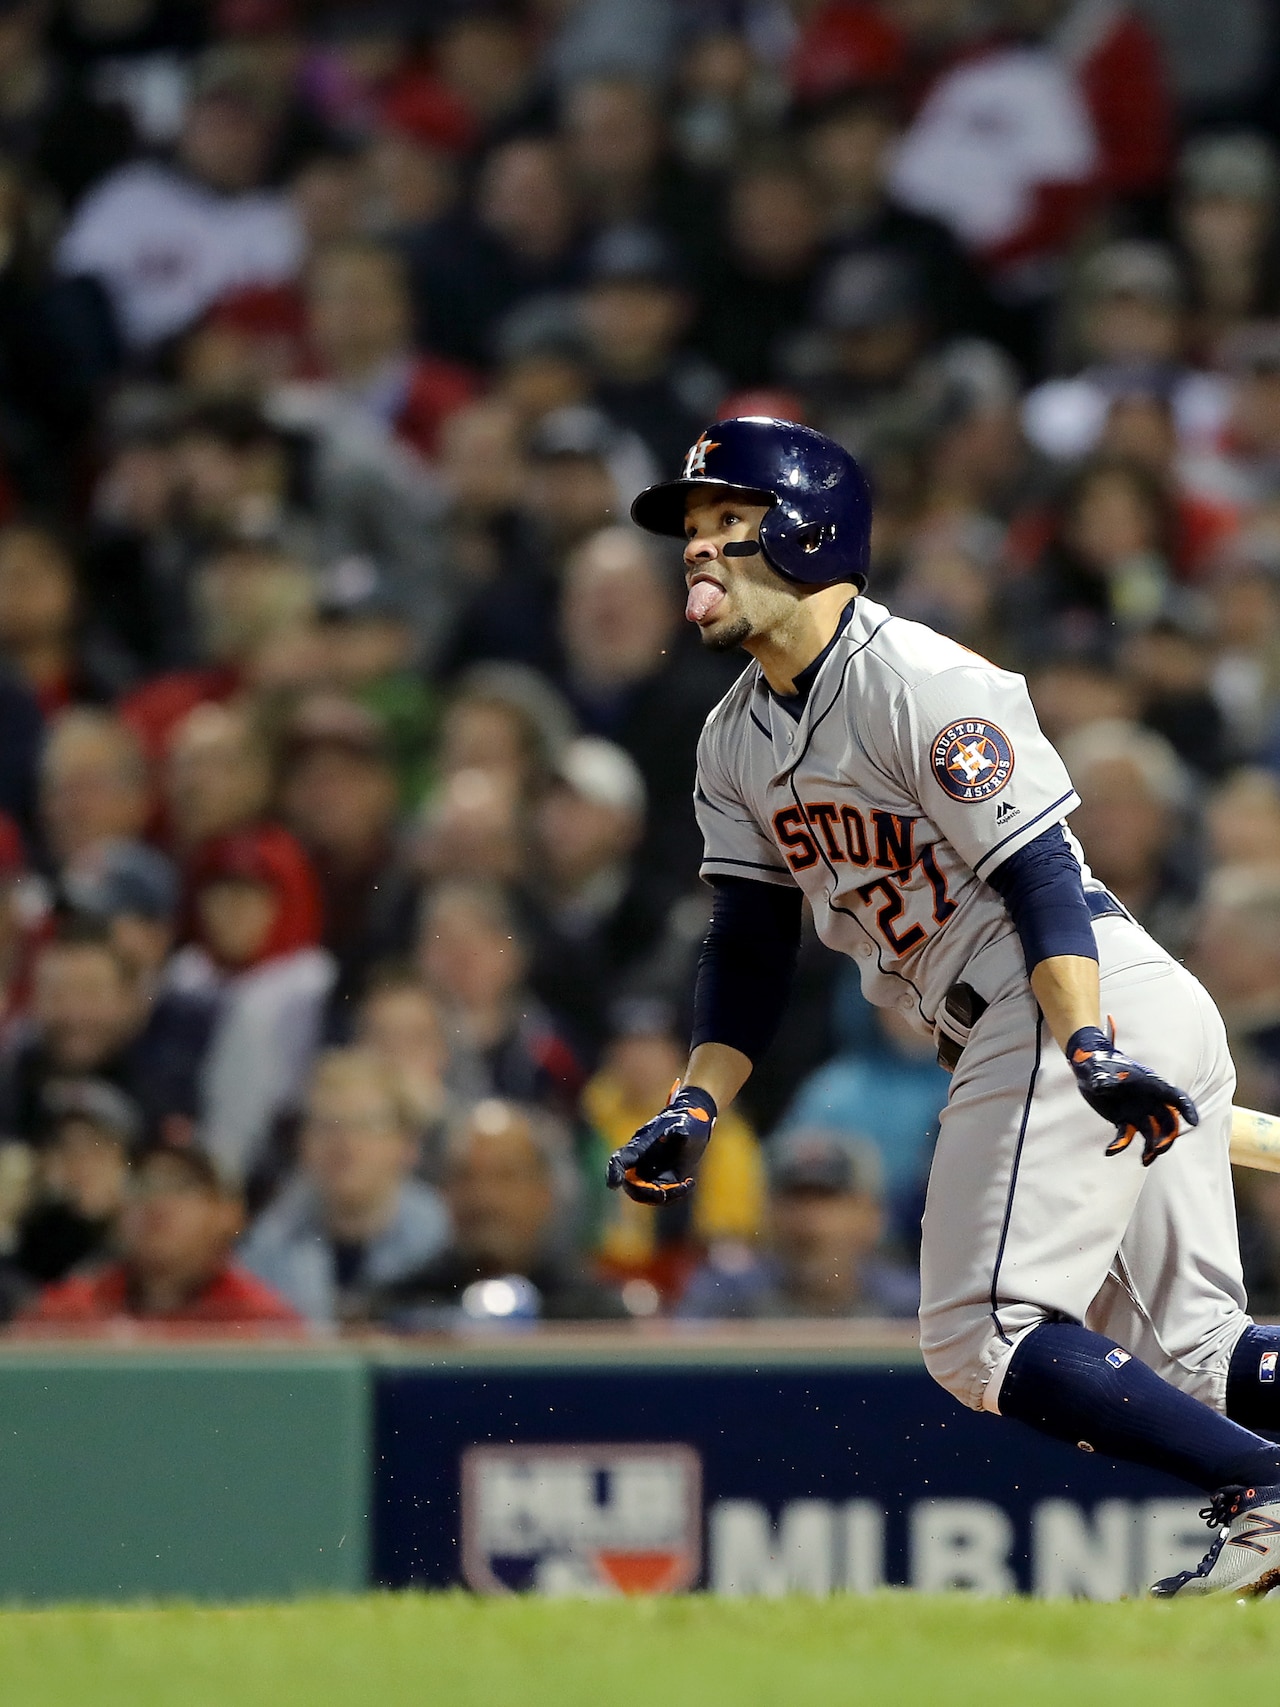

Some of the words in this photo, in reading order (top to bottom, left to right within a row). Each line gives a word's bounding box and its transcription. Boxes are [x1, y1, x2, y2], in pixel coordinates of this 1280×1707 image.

[935, 722, 986, 767] HOUSTON
[963, 760, 1010, 798] ASTROS
[772, 802, 917, 873] STON
[857, 844, 960, 958] 27
